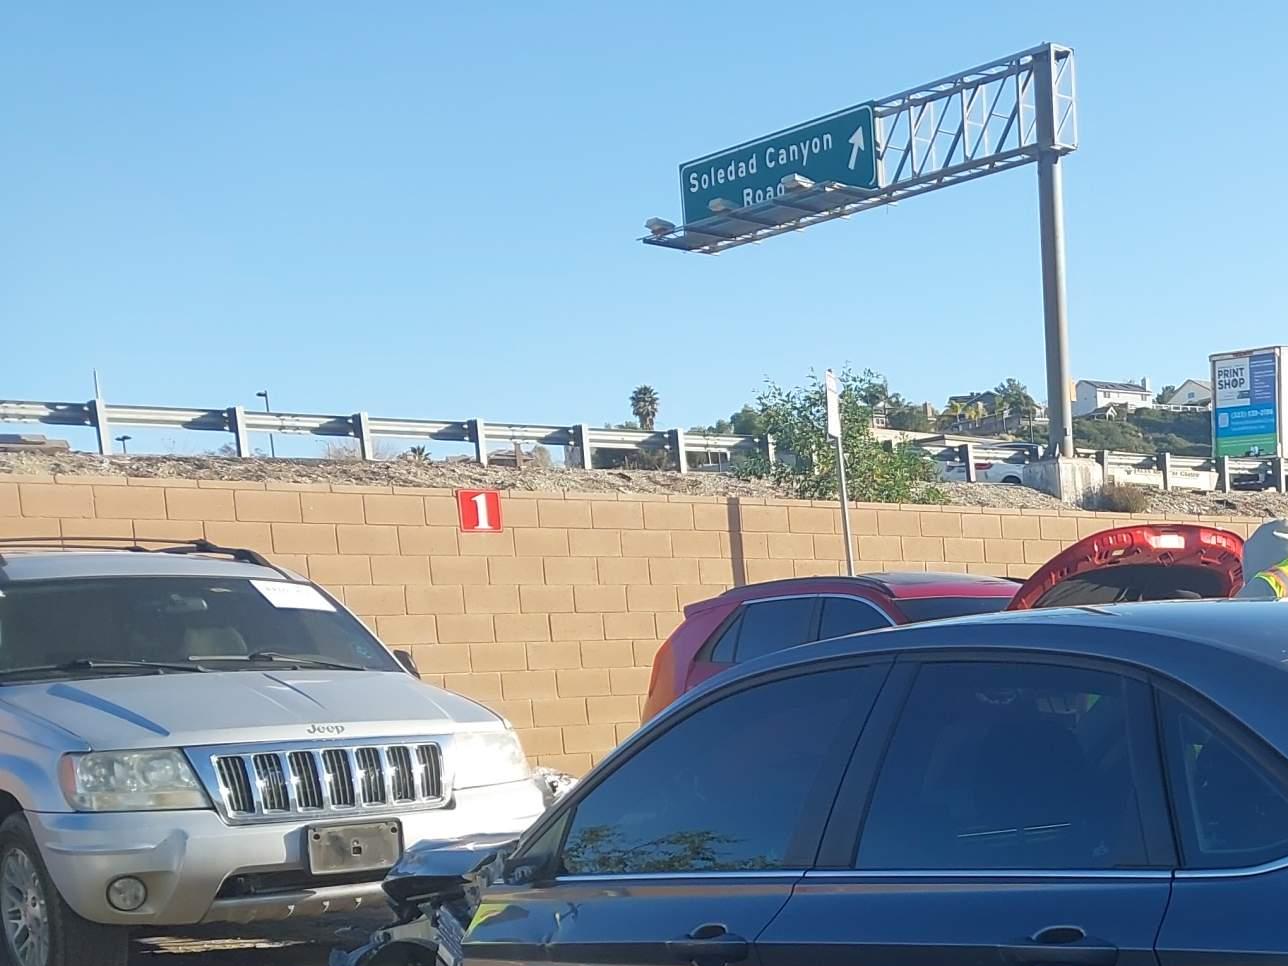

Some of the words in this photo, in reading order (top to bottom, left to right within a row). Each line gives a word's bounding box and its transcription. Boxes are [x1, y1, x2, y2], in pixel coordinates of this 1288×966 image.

[689, 153, 757, 193] Soledad
[765, 132, 833, 167] Canyon
[1217, 367, 1245, 379] PRINT
[1217, 377, 1246, 390] SHOP
[470, 492, 494, 530] 1
[306, 723, 345, 735] Jeep
